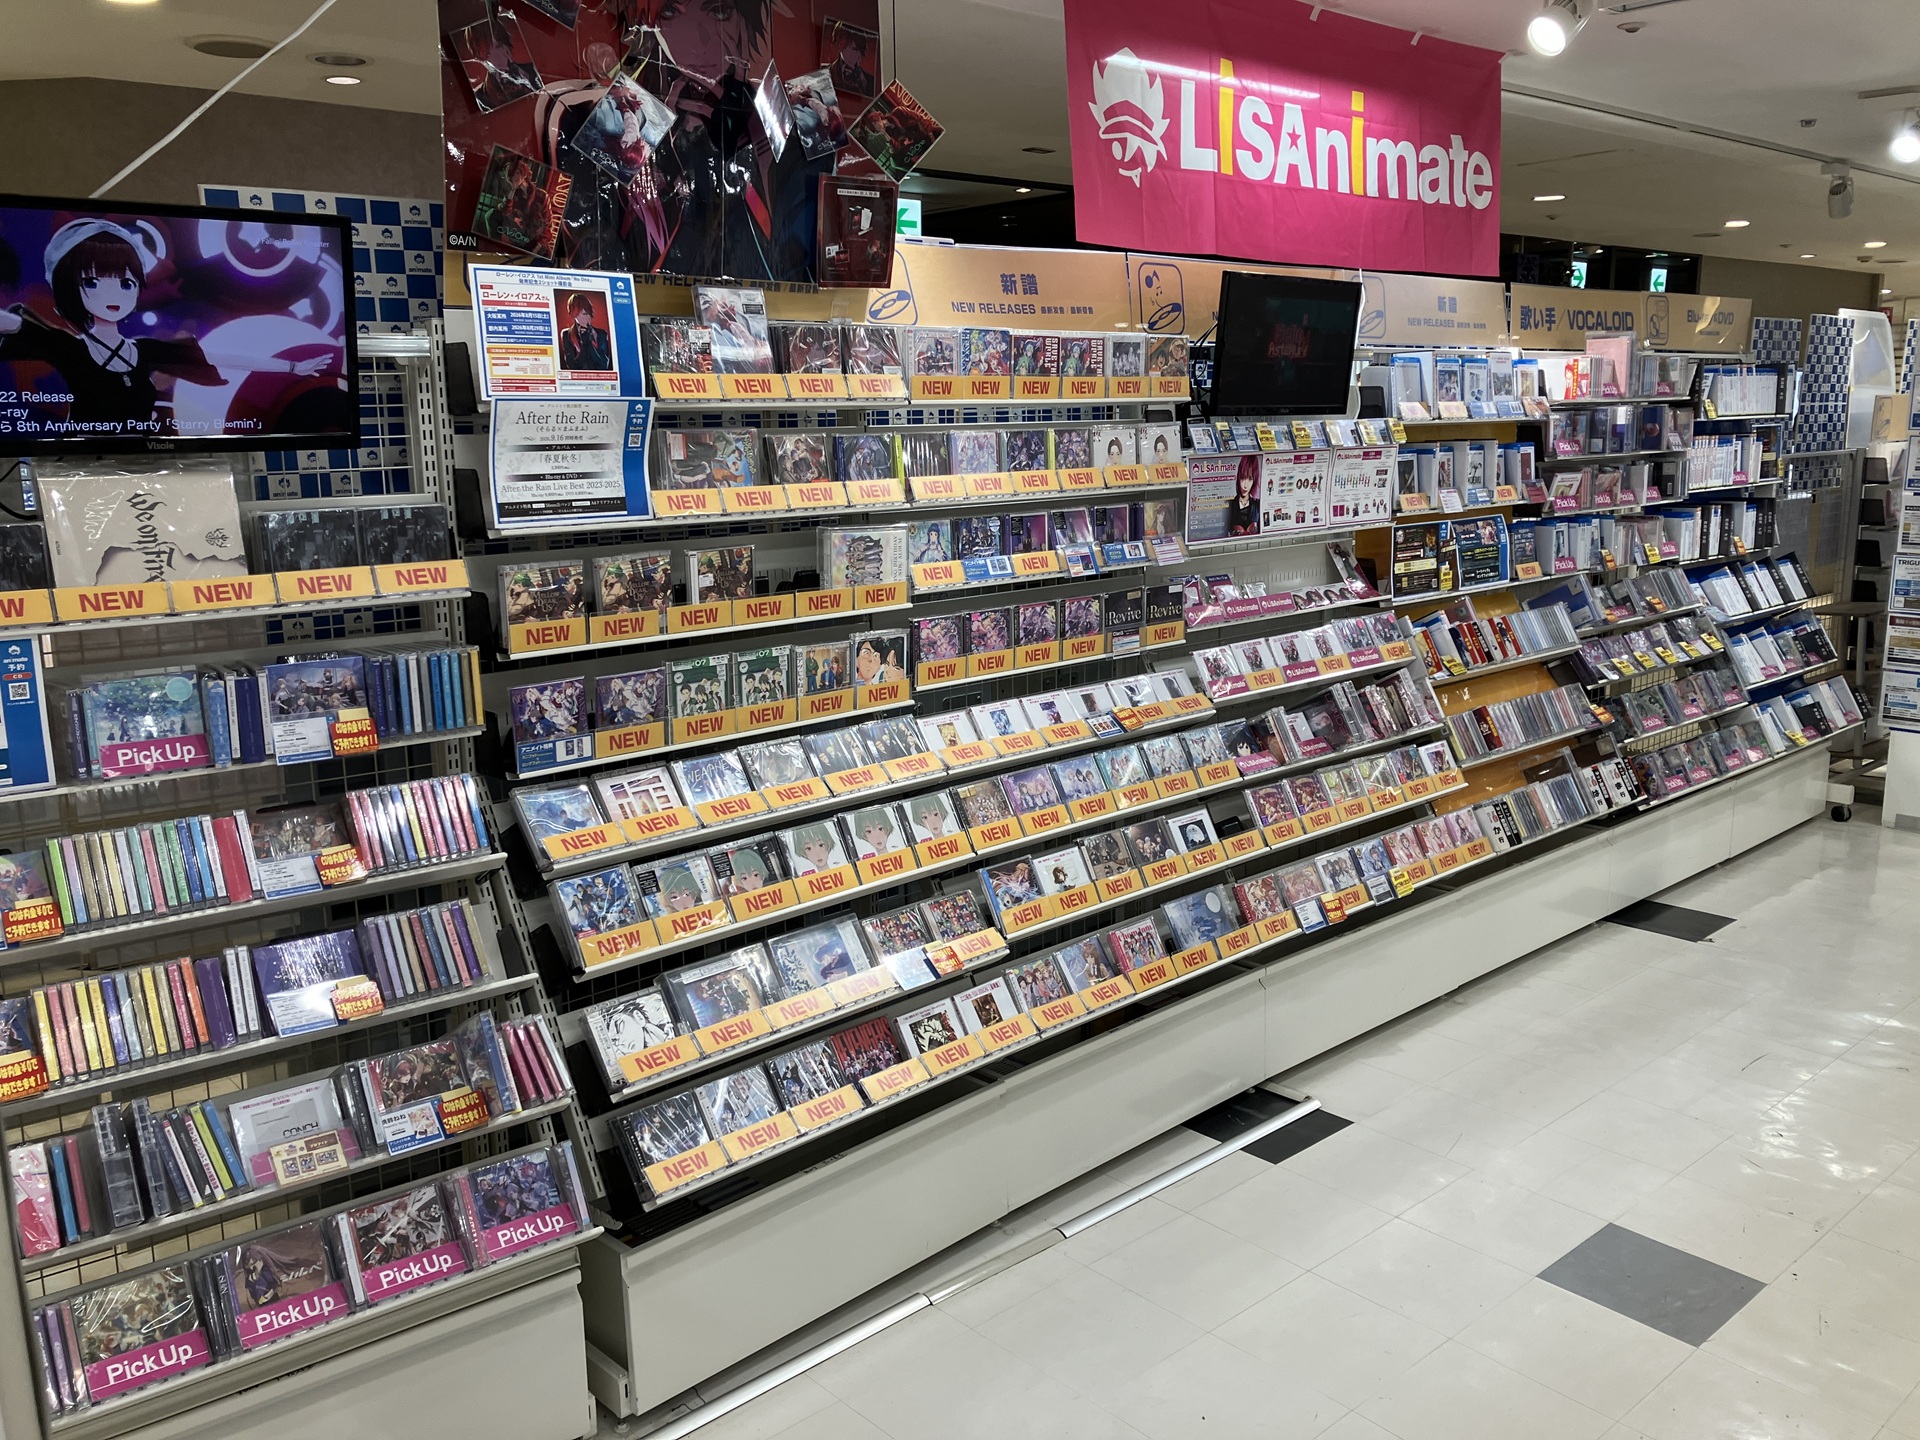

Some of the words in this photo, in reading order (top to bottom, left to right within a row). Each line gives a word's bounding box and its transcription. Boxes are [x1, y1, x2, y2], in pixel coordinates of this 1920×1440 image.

[449, 234, 476, 247] ©A/N
[951, 301, 975, 313] NEW
[979, 302, 1036, 315] RELEASES
[1407, 317, 1421, 326] NEW
[1423, 317, 1455, 328] RELEASES
[669, 379, 706, 392] NEW
[735, 379, 771, 393] NEW
[799, 379, 833, 392] NEW
[922, 382, 951, 394] NEW
[972, 382, 999, 394] NEW
[22, 391, 74, 402] Release
[516, 411, 551, 424] After
[556, 411, 577, 424] the
[580, 411, 609, 424] Rain
[17, 420, 41, 432] 8th
[45, 420, 123, 434] Anniversary
[127, 419, 161, 433] Party
[501, 485, 520, 493] After
[522, 484, 533, 492] the
[535, 483, 552, 491] Rain
[553, 482, 568, 491] Live
[570, 482, 584, 490] Best
[586, 480, 621, 489] 2023-2025
[736, 492, 772, 506] NEW
[799, 488, 832, 501] NEW
[667, 495, 706, 510] NEW
[396, 568, 446, 585] NEW
[923, 567, 952, 579] NEW
[298, 576, 351, 593] NEW
[194, 583, 252, 602] NEW
[866, 589, 895, 602] NEW
[80, 592, 143, 611] NEW
[808, 595, 840, 609] NEW
[747, 602, 780, 616] NEW
[1150, 601, 1182, 619] Revive
[681, 609, 717, 624] NEW
[1109, 608, 1142, 626] Revive
[604, 618, 644, 635] NEW
[526, 627, 569, 644] NEW
[8, 663, 25, 672] 予約
[928, 665, 955, 678] NEW
[1323, 659, 1343, 671] NEW
[1253, 673, 1275, 686] NEW
[869, 687, 897, 701] NEW
[811, 697, 841, 712] NEW
[750, 708, 783, 722] NEW
[687, 719, 722, 734] NEW
[609, 731, 648, 749] NEW
[952, 747, 982, 758] NEW
[839, 771, 873, 784] NEW
[1207, 767, 1228, 778] NEW
[1439, 773, 1458, 786] NEW
[777, 786, 812, 800] NEW
[1409, 783, 1429, 796] NEW
[711, 800, 750, 816] NEW
[1080, 800, 1105, 813] NEW
[1344, 802, 1365, 817] NEW
[637, 815, 678, 832] NEW
[1032, 814, 1059, 826] NEW
[1311, 813, 1332, 826] NEW
[981, 826, 1010, 840] NEW
[1271, 823, 1295, 839] NEW
[561, 831, 606, 850] NEW
[1232, 839, 1253, 850] NEW
[928, 842, 958, 857] NEW
[1468, 843, 1486, 856] NEW
[870, 858, 902, 874] NEW
[1439, 854, 1458, 868] NEW
[808, 874, 843, 892] NEW
[1106, 879, 1131, 892] NEW
[745, 891, 782, 910] NEW
[1060, 893, 1087, 907] NEW
[1339, 888, 1361, 905] NEW
[1013, 906, 1042, 923] NEW
[1266, 917, 1288, 935] NEW
[597, 932, 640, 955] NEW
[1227, 933, 1248, 947] NEW
[1182, 952, 1206, 966] NEW
[1139, 967, 1166, 982] NEW
[1091, 985, 1120, 1000] NEW
[1042, 1004, 1072, 1019] NEW
[711, 1021, 752, 1044] NEW
[989, 1024, 1022, 1040] NEW
[635, 1046, 680, 1071] NEW
[935, 1045, 969, 1063] NEW
[806, 1097, 845, 1120] NEW
[737, 1123, 780, 1149] NEW
[663, 1152, 708, 1180] NEW
